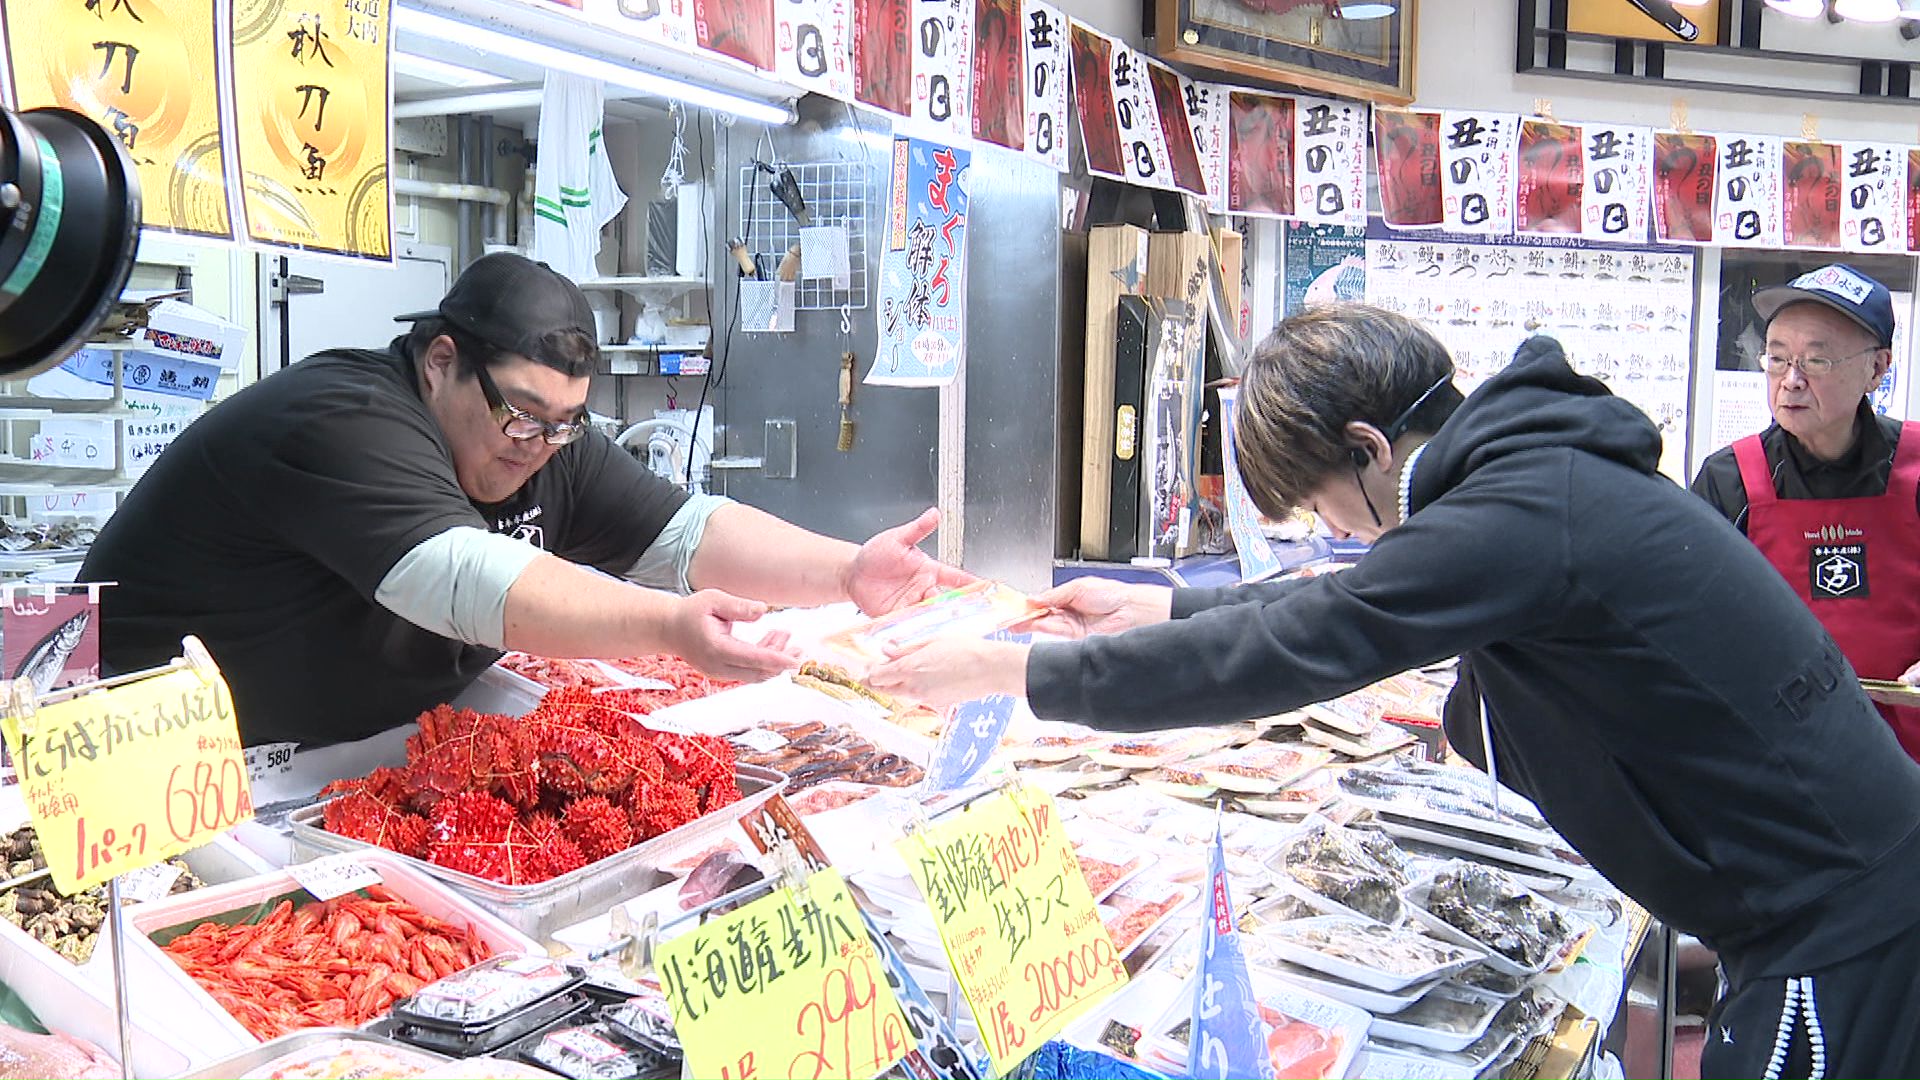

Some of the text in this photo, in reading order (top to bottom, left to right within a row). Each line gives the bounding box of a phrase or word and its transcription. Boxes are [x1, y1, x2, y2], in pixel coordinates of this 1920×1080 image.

[287, 16, 338, 196] 秋刀魚
[1030, 10, 1053, 153] 丑の日
[1115, 51, 1155, 177] 丑の日
[1209, 125, 1220, 196] 七月二十六日
[1303, 104, 1344, 215] 丑の日
[1351, 142, 1363, 209] 七月二十六日
[1447, 117, 1489, 225] 丑の日
[1497, 152, 1508, 218] 七月二十六日
[1588, 131, 1628, 234] 丑の日
[1725, 139, 1761, 239] 丑の日
[1849, 148, 1887, 246] 丑の日
[905, 217, 937, 330] 解体
[929, 148, 965, 306] まぐろ
[15, 681, 229, 781] たらばがにふんどし
[267, 748, 291, 769] 580
[38, 792, 80, 820] 生食用
[75, 817, 148, 881] 1パック
[165, 758, 252, 842] 680円
[661, 891, 856, 1024] 北海道産生サバ
[993, 874, 1070, 964] 生サンマ
